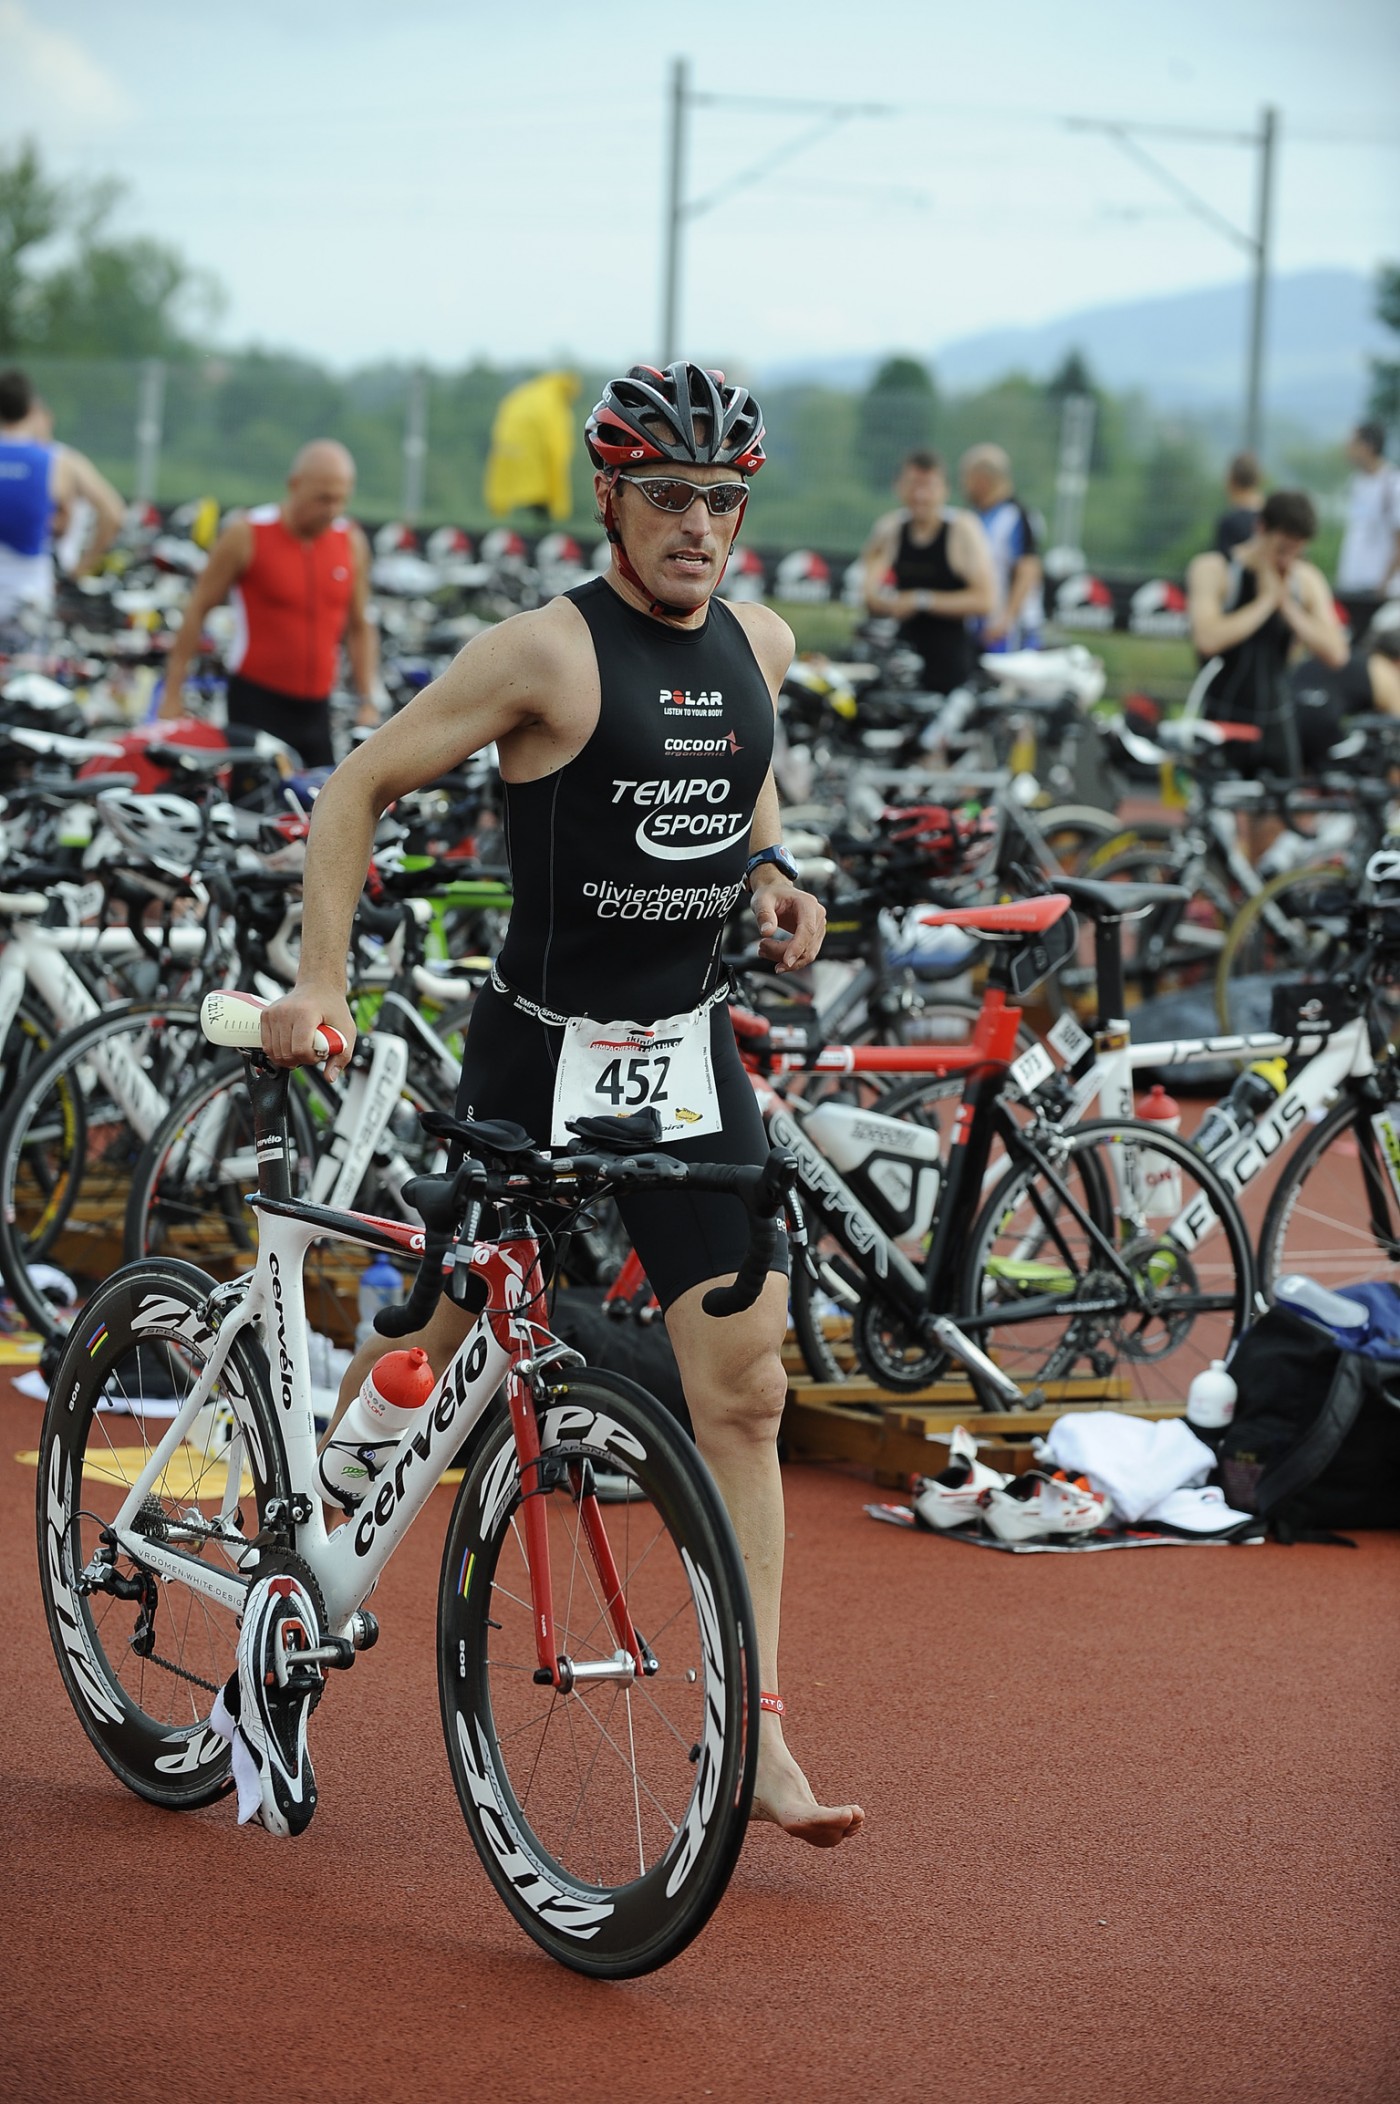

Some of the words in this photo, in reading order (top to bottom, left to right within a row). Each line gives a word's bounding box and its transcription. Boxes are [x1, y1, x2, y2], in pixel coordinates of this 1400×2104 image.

[659, 689, 723, 706] POLAR
[664, 708, 683, 716] LISTEN
[684, 708, 691, 717] TO
[692, 709, 707, 717] YOUR
[708, 709, 723, 717] BODY
[664, 738, 728, 752] cocoon
[611, 779, 731, 806] TEMPO
[651, 813, 743, 836] SPORT
[596, 890, 739, 921] coaching
[517, 995, 540, 1012] TEMPO
[541, 1009, 568, 1024] SPORT
[595, 1056, 671, 1106] 452
[1185, 1095, 1307, 1241] FCUS
[269, 1252, 295, 1411] cervélo
[68, 1381, 81, 1412] 808
[354, 1335, 488, 1558] cervélo
[456, 1710, 615, 1940] ZIPP
